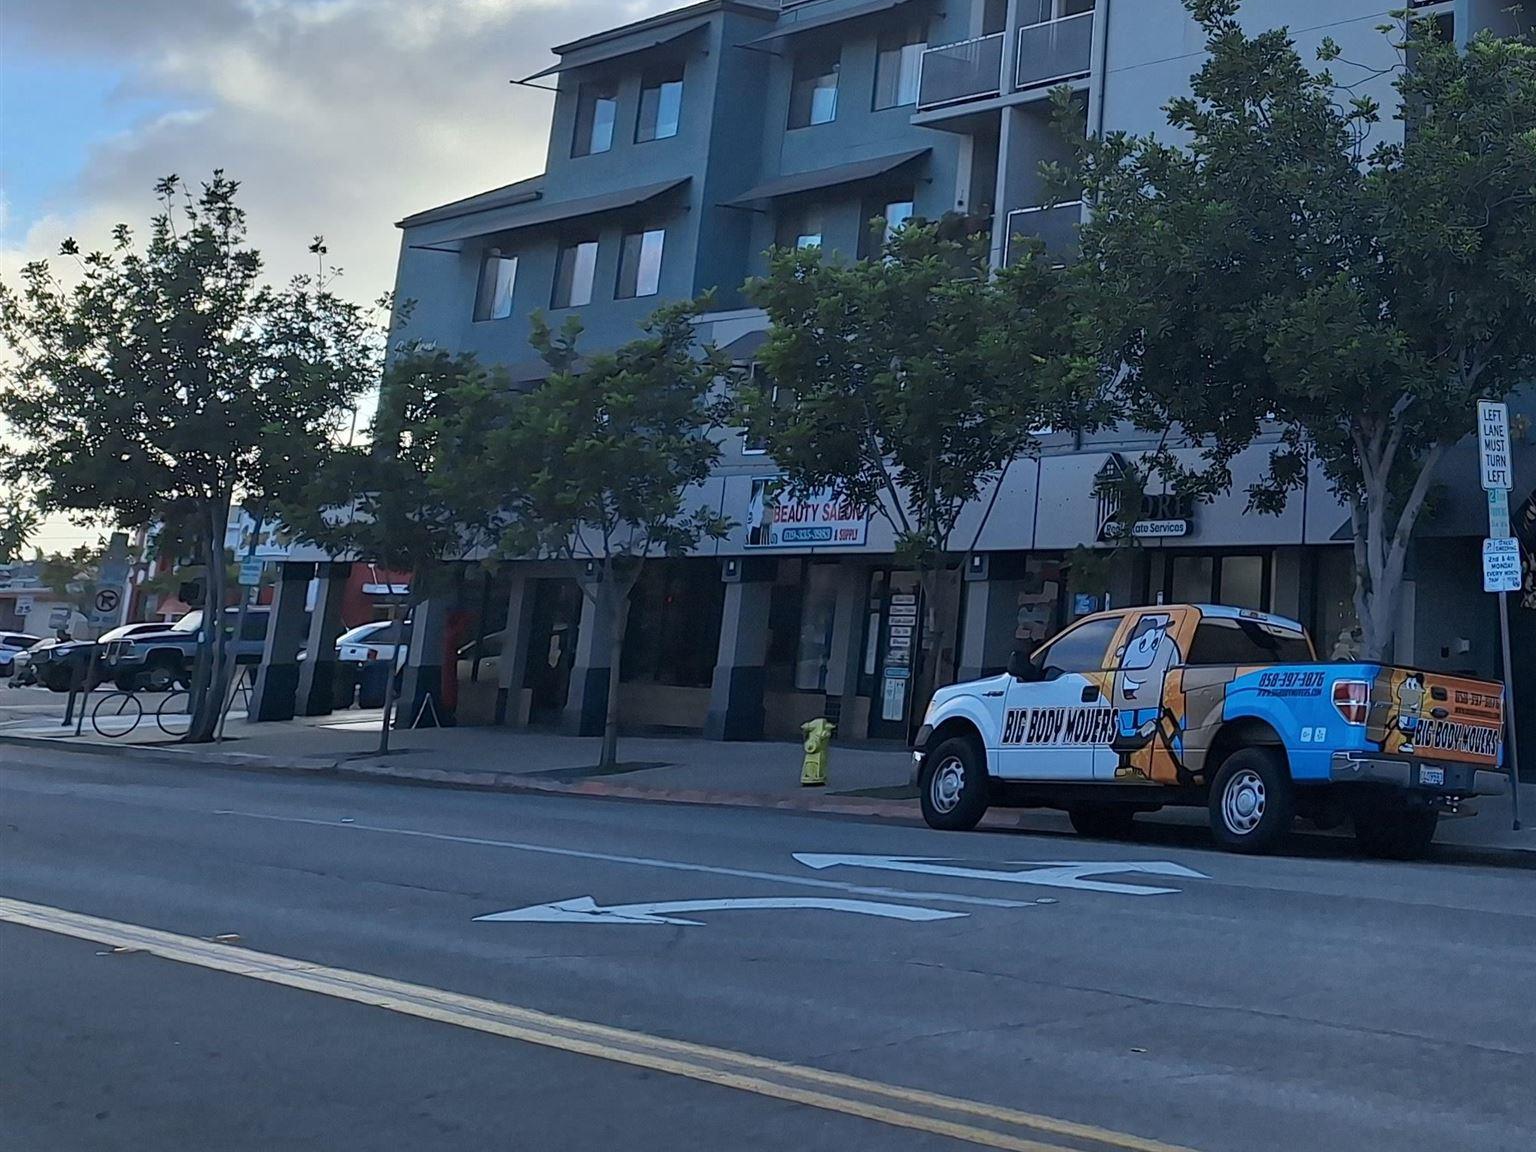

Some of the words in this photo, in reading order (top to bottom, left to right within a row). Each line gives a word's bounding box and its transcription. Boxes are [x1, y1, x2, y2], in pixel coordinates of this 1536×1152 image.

[1483, 409, 1501, 422] LEFT
[1483, 424, 1504, 437] LANE
[1484, 439, 1505, 452] MUST
[1485, 454, 1507, 467] TURN
[1487, 470, 1507, 485] LEFT
[773, 503, 819, 523] BEAUTY
[1149, 523, 1184, 533] Services
[1003, 709, 1027, 744] BIG
[1027, 709, 1065, 744] BODY
[1414, 719, 1435, 746] BIG
[1434, 722, 1461, 750] BODY
